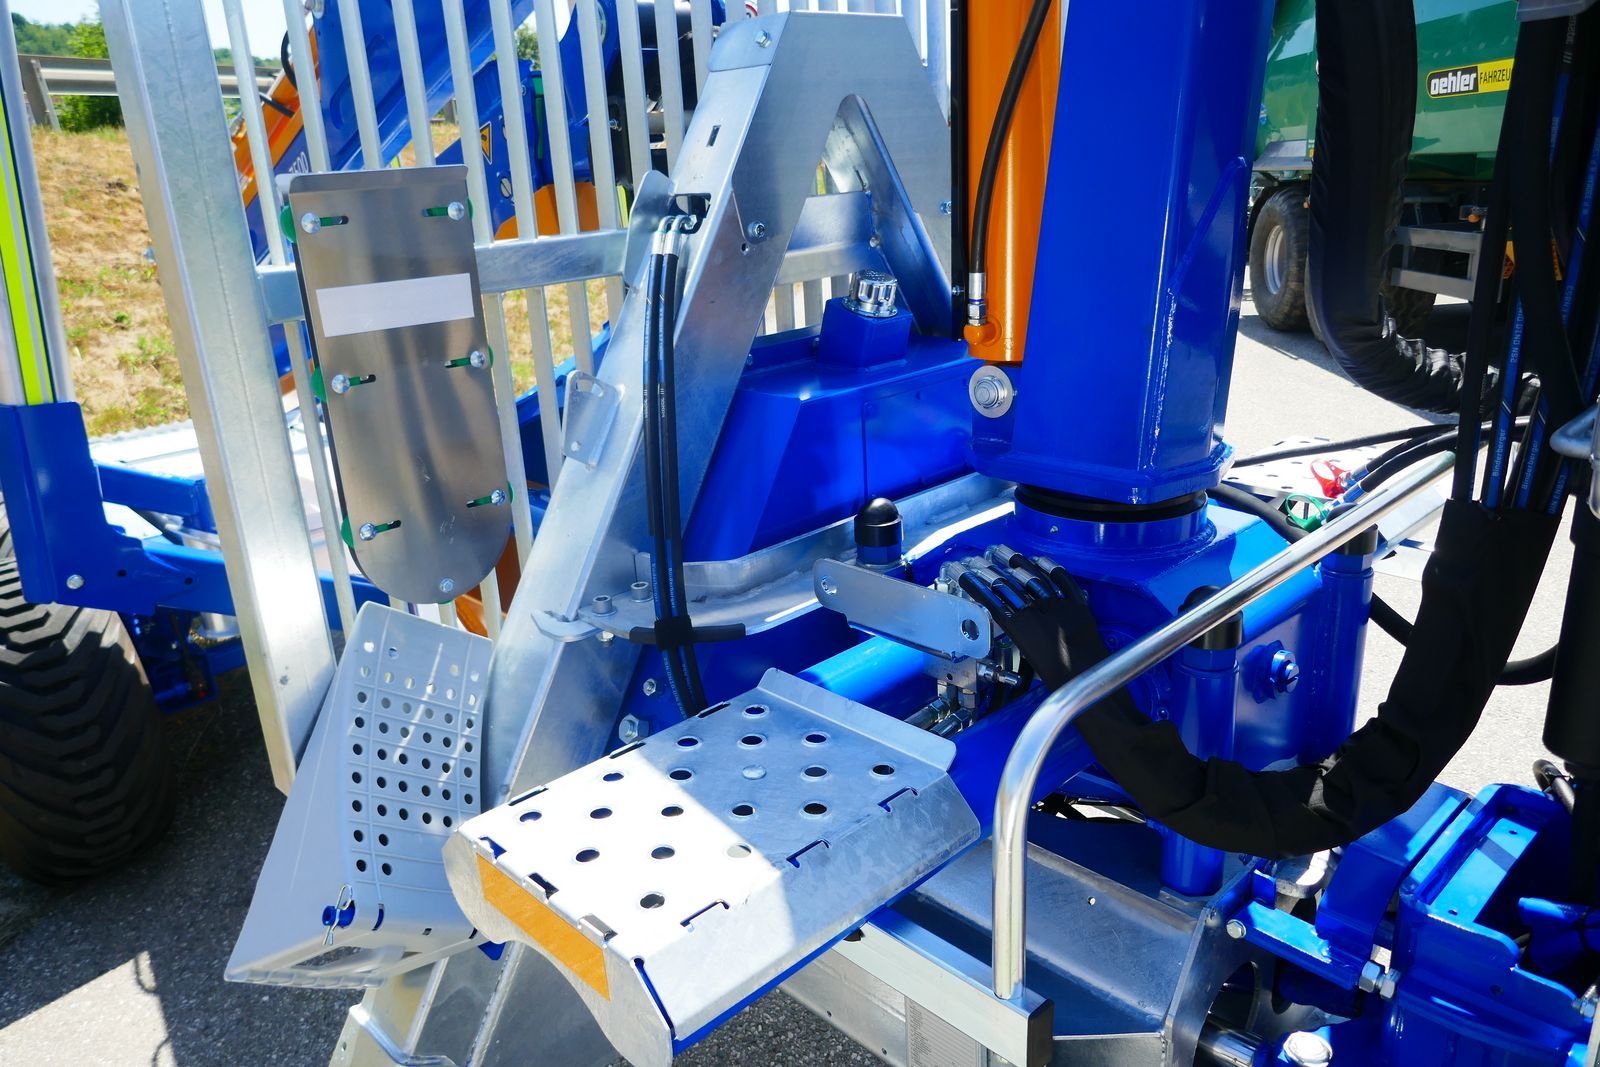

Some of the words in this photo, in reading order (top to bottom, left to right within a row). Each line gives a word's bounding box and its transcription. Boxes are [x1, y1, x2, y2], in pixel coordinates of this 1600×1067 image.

[1430, 71, 1477, 96] oehler
[1492, 428, 1506, 477] Binderberger
[1521, 440, 1539, 490] Binderberger
